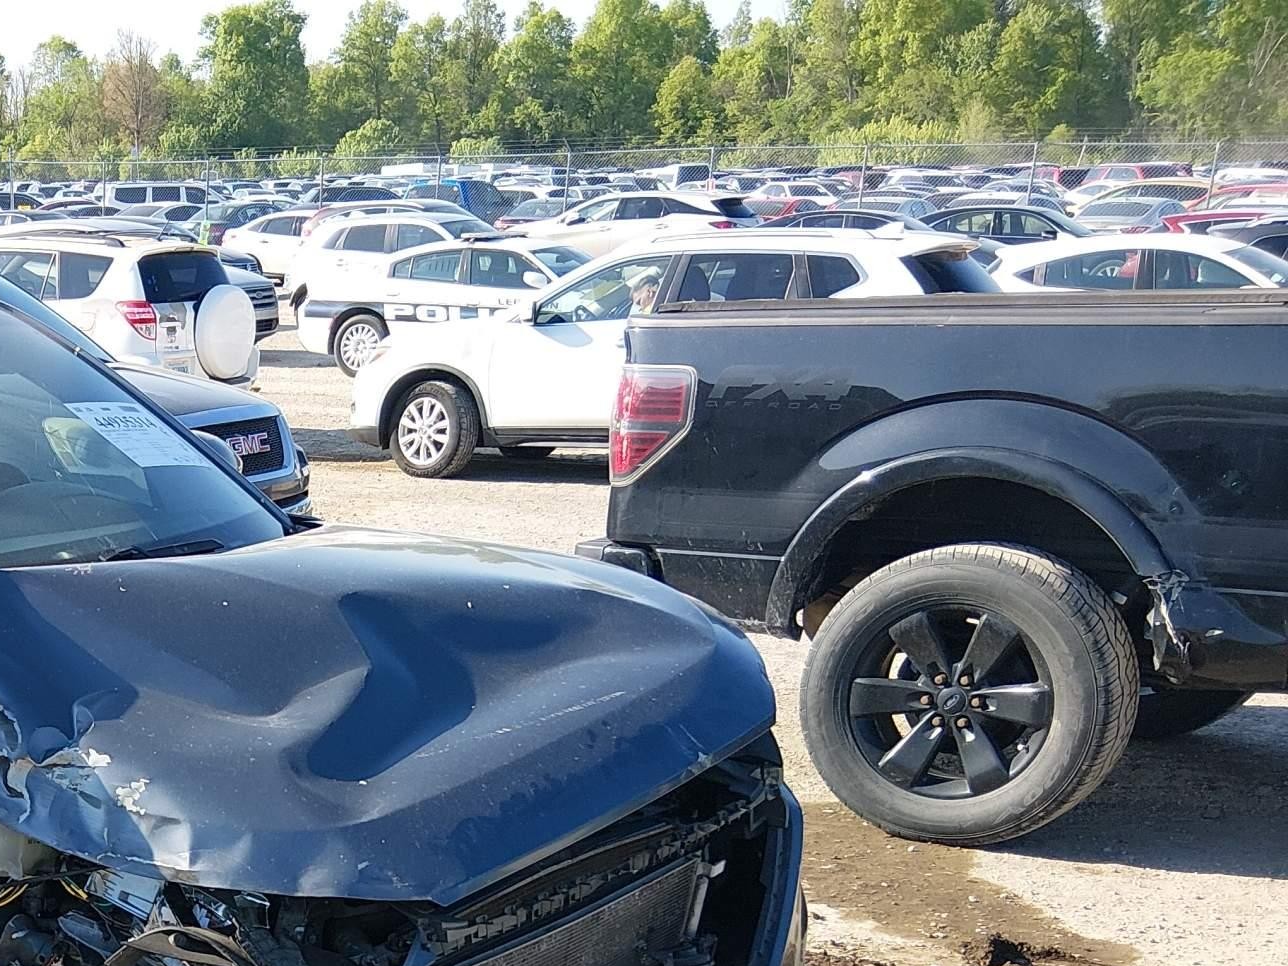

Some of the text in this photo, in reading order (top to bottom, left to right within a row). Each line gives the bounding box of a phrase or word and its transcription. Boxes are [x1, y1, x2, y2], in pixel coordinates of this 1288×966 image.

[707, 364, 856, 401] FX4
[767, 401, 842, 411] ROAD
[94, 415, 157, 428] 44935314
[226, 432, 270, 456] GMC
